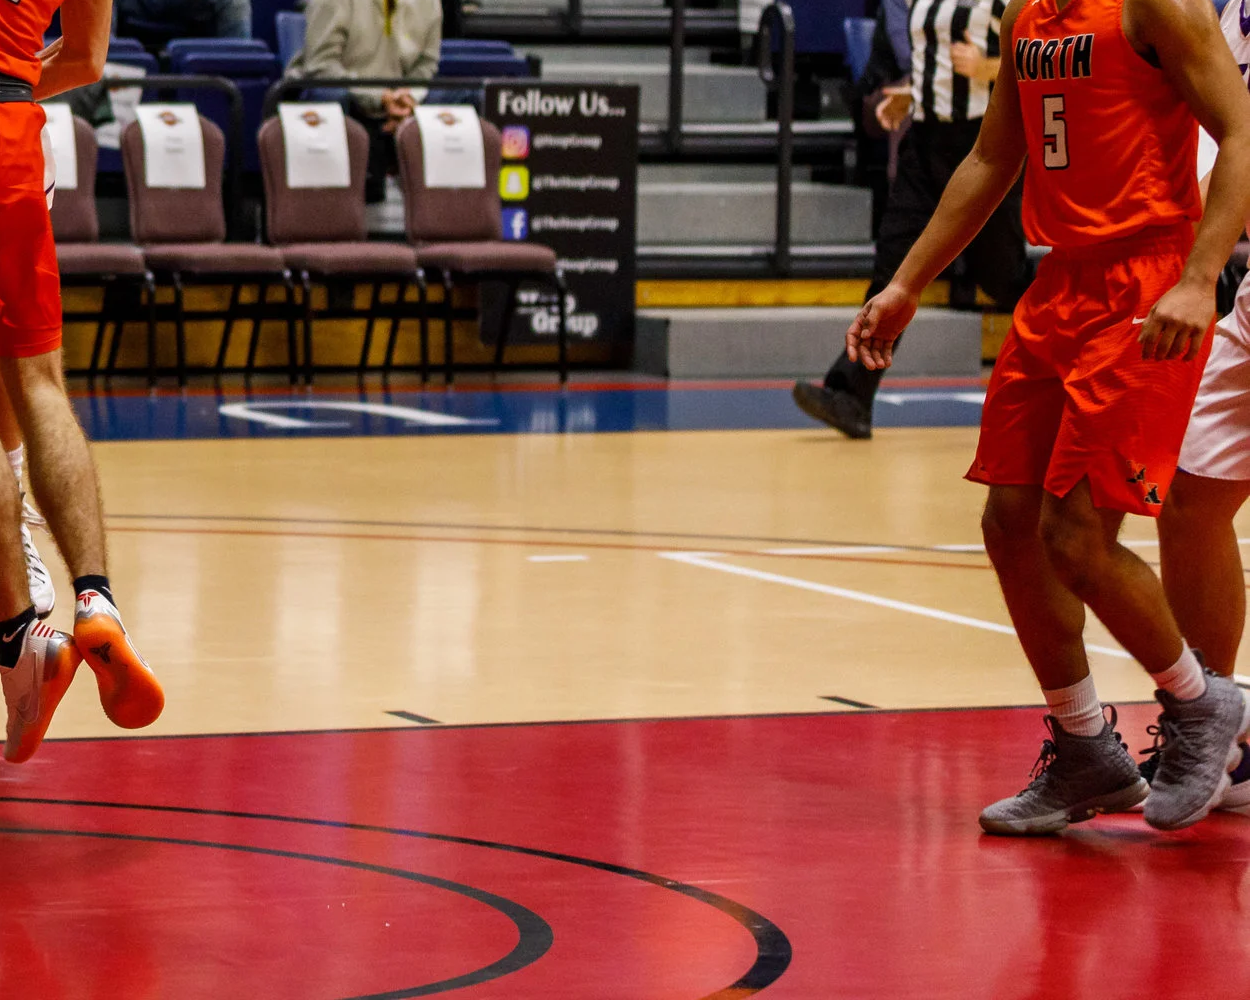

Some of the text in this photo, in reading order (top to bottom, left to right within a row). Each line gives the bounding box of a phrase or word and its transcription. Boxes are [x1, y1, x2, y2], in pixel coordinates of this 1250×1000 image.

[1015, 33, 1094, 82] NORTH
[498, 88, 575, 116] Follow
[1042, 93, 1070, 170] 5
